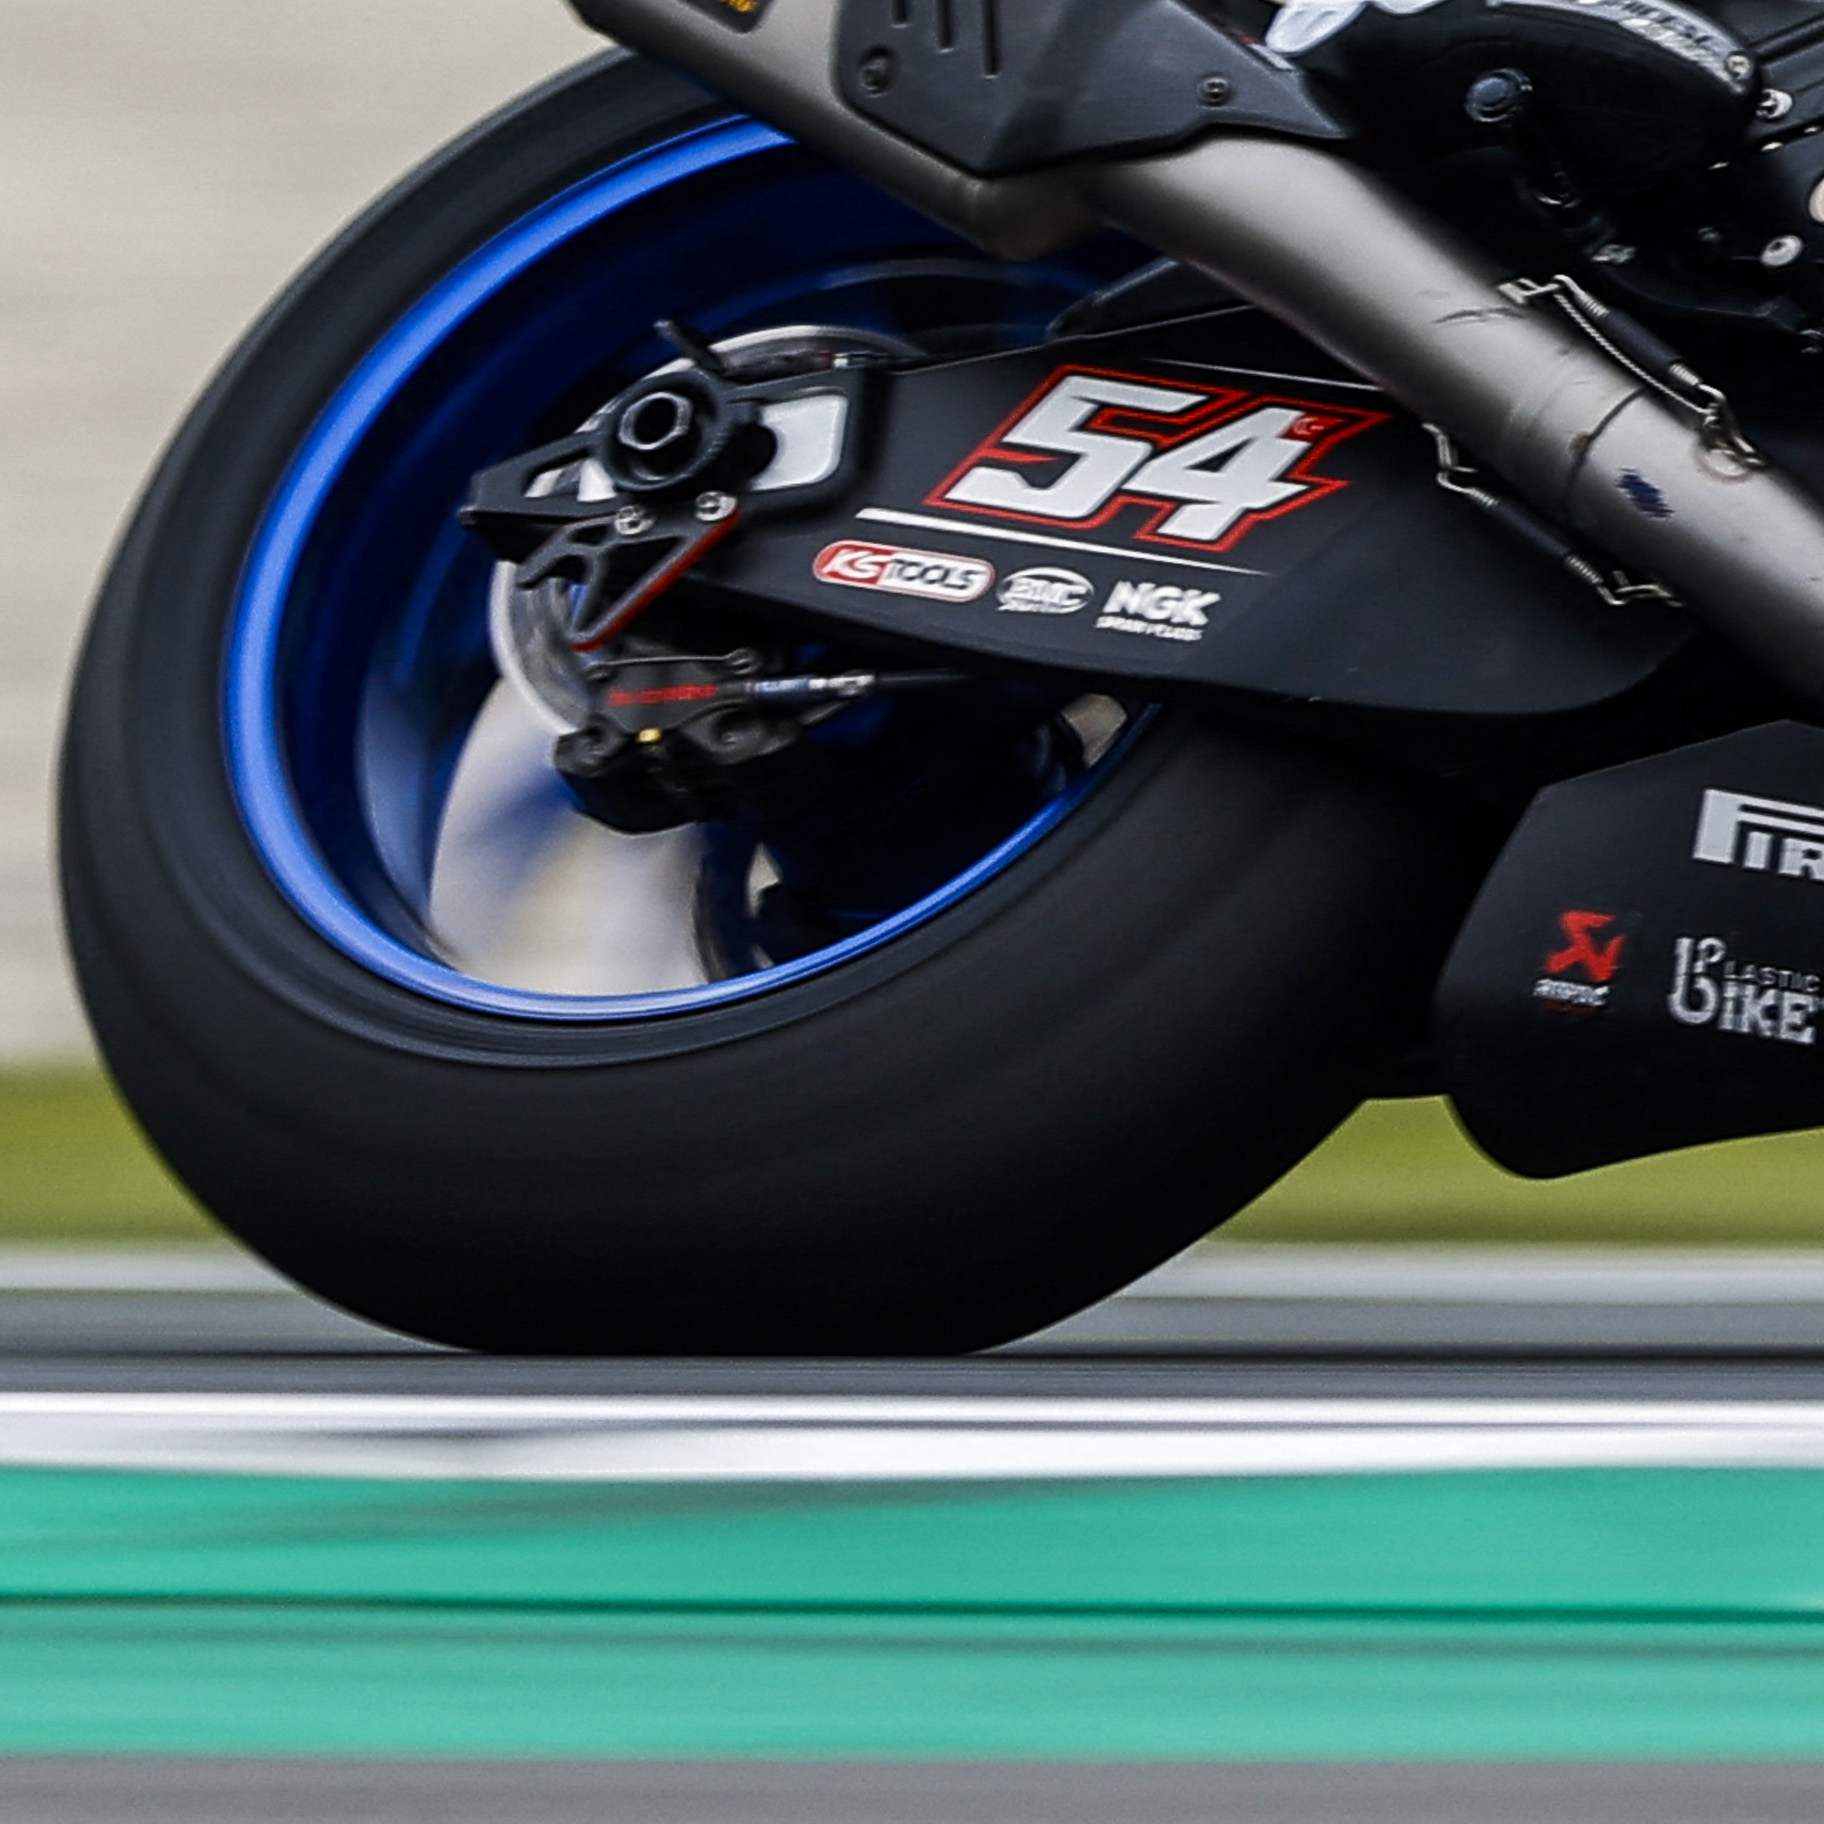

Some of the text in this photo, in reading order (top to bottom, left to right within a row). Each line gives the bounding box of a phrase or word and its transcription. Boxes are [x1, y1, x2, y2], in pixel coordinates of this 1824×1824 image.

[943, 372, 1314, 542] 54
[888, 557, 986, 592] TOOLS
[1102, 580, 1221, 626] NGK
